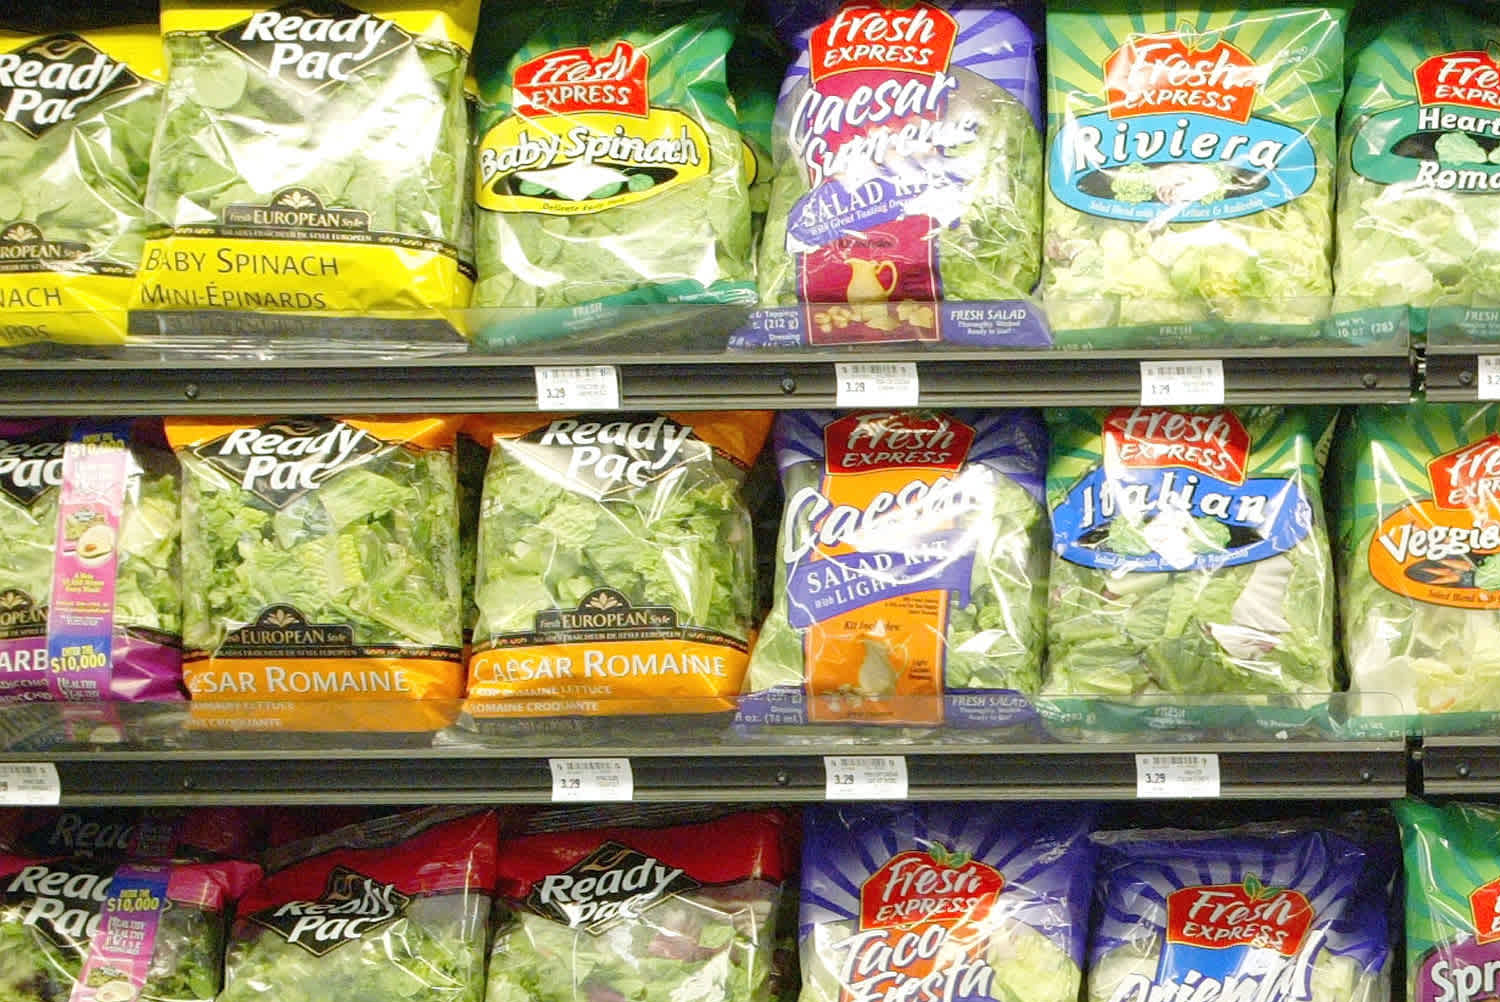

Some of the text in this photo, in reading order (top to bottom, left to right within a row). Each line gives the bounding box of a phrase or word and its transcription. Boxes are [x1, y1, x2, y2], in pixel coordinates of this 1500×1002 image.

[240, 11, 395, 47] Ready
[829, 6, 936, 45] Fresh
[268, 43, 356, 81] Pac
[532, 44, 633, 85] Fresh
[824, 43, 933, 66] EXPRESS
[532, 84, 630, 107] EXPRESS
[791, 70, 959, 150] Caesar
[1127, 88, 1237, 111] EXPRESS
[479, 126, 699, 182] Baby Spinach
[1075, 120, 1287, 170] Riviera
[254, 209, 340, 228] EUROPEAN
[146, 247, 338, 276] BABY SPINACH
[219, 426, 366, 464] Ready
[541, 418, 693, 463] Ready
[1124, 409, 1231, 447] Fresh
[242, 456, 325, 490] Pac
[566, 447, 656, 489] Pac
[843, 449, 949, 466] EXPRESS
[1121, 444, 1228, 471] EXPRESS
[1083, 471, 1270, 528] Italian
[241, 628, 325, 645] EUROPEAN
[562, 611, 648, 628] EUROPEAN
[265, 666, 410, 693] ROMAINE
[584, 649, 727, 678] ROMAINE
[541, 857, 684, 902] Ready
[1187, 889, 1293, 924] Fresh
[287, 914, 366, 943] Pac
